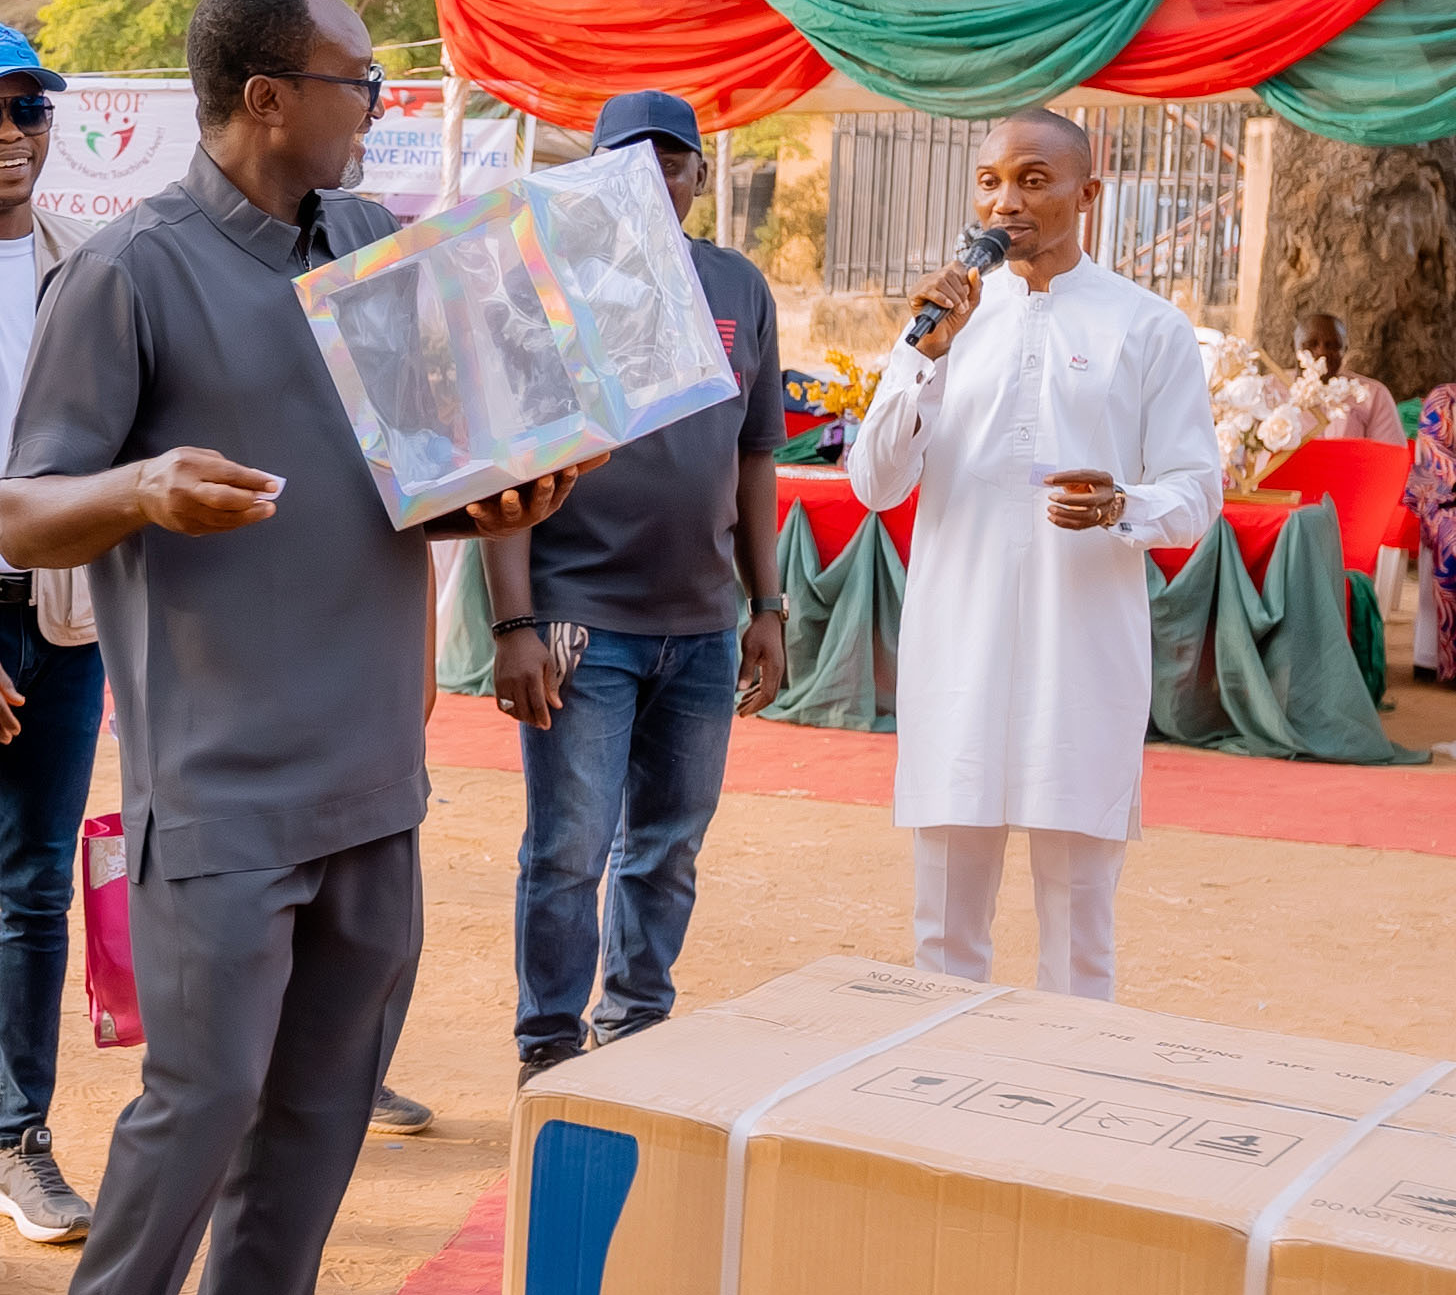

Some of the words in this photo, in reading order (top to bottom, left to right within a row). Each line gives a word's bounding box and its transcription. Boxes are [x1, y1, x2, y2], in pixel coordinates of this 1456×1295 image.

[364, 130, 475, 148] ATERLIT
[364, 149, 399, 165] AVE
[404, 151, 508, 167] INITTIVE!
[32, 193, 65, 212] AY
[70, 194, 86, 214] &
[92, 195, 144, 216] OM
[867, 970, 892, 983] ON
[892, 977, 936, 993] STEP
[1099, 1031, 1136, 1042] THE
[1155, 1040, 1244, 1060] BINDING
[1267, 1059, 1316, 1072] TAPE
[1335, 1072, 1394, 1087] OPEN
[1310, 1198, 1344, 1211] DO
[1351, 1206, 1394, 1223] NOT
